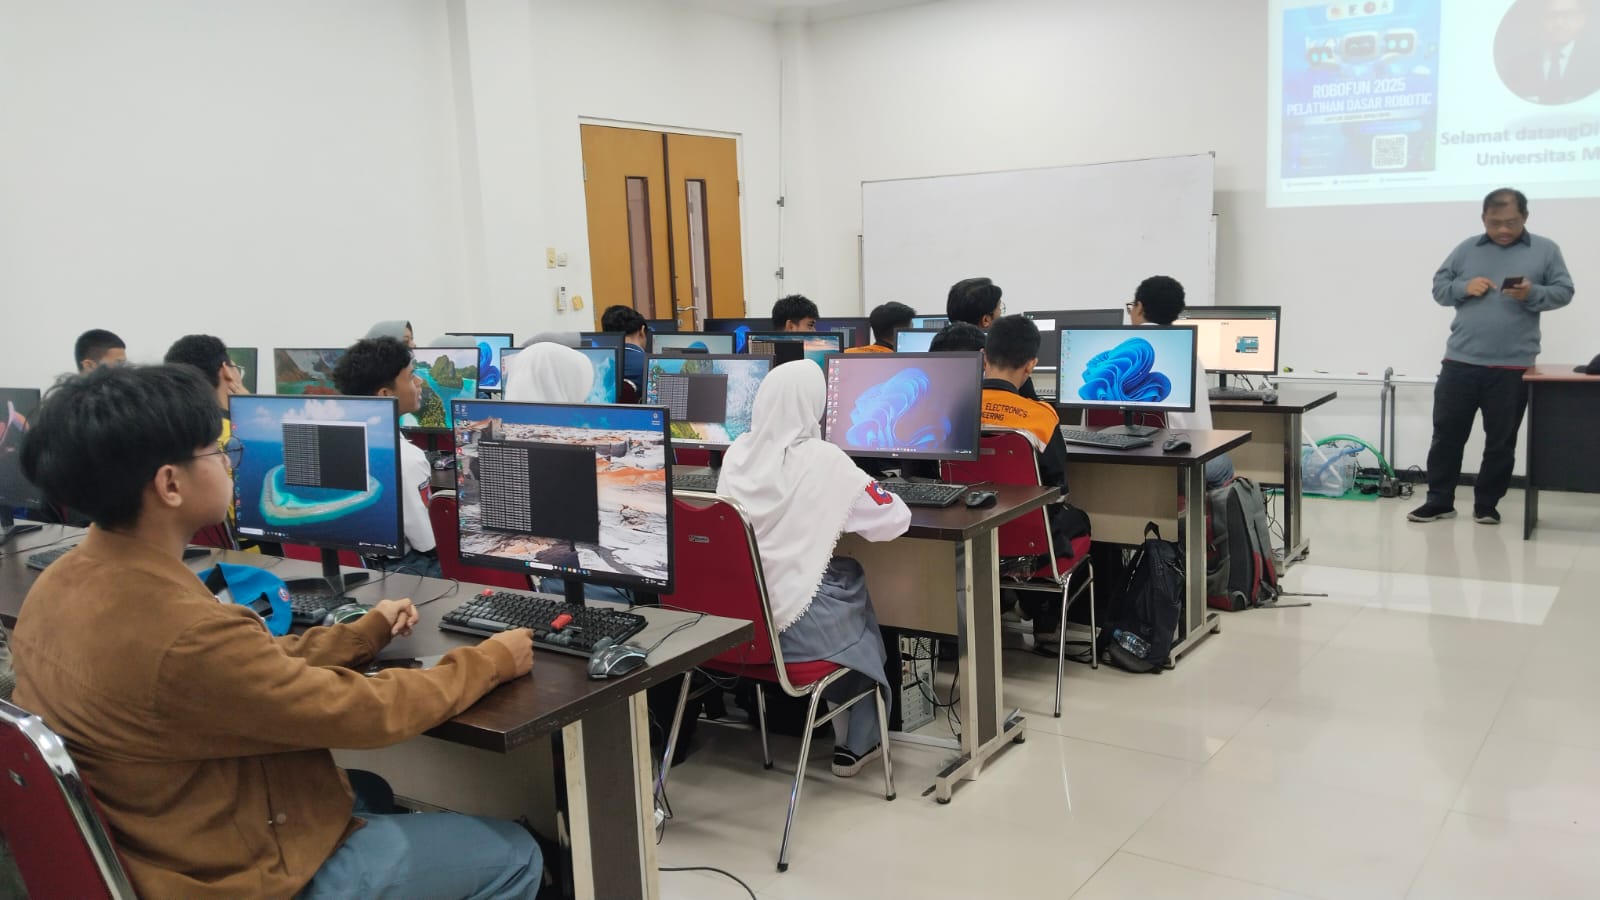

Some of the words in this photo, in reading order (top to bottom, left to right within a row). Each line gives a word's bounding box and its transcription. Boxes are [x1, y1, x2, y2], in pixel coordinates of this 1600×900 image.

[1312, 80, 1371, 98] ROBOFUN
[1374, 77, 1406, 93] 2025
[1286, 100, 1345, 116] PELATIHAN
[1346, 96, 1382, 111] DASAR
[1384, 93, 1432, 107] ROBOTIC
[1440, 129, 1511, 145] Selamat
[1477, 150, 1576, 166] Universitas
[985, 402, 1028, 418] ELECTRONICS
